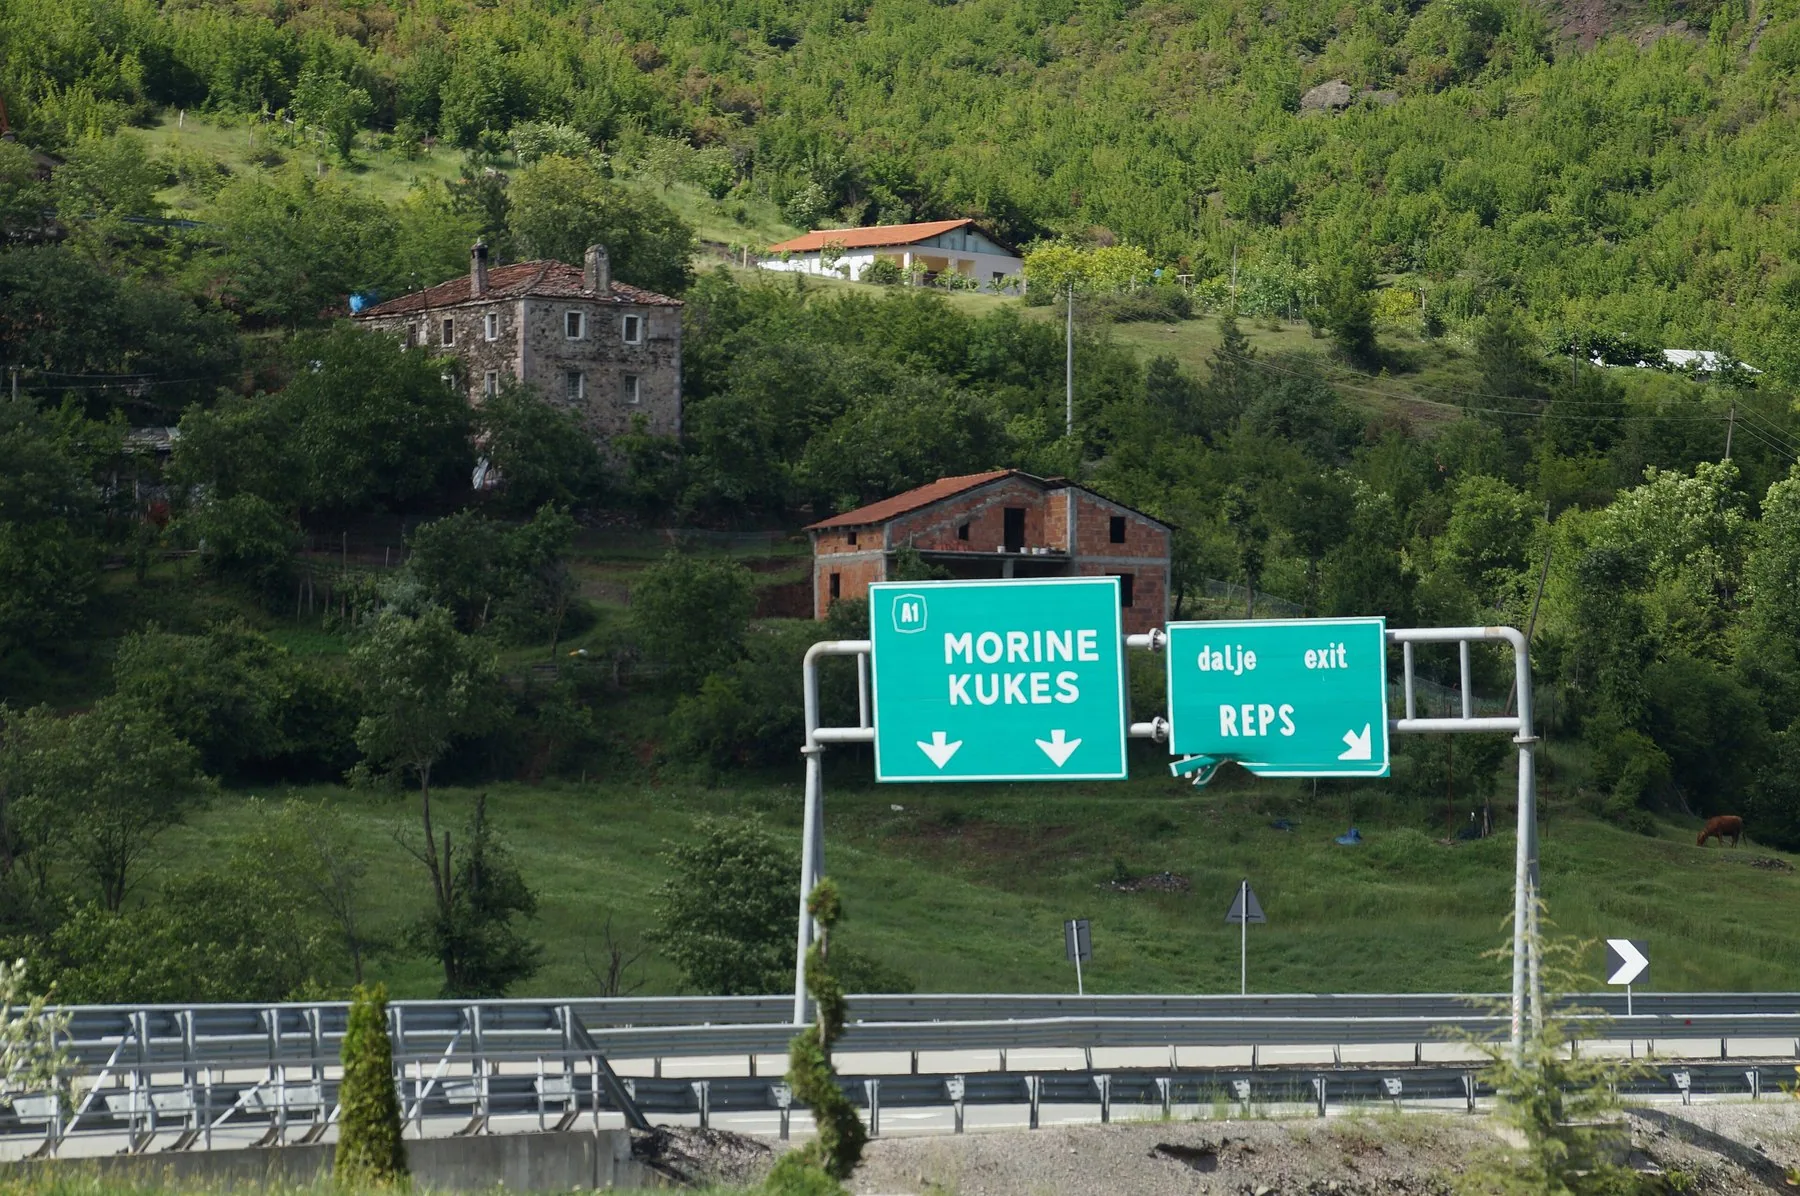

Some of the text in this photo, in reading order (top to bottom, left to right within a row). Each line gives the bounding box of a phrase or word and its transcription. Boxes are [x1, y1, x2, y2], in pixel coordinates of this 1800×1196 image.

[901, 602, 920, 623] A1
[943, 629, 1100, 665] MORINE
[1197, 644, 1257, 676] dalje
[1304, 642, 1348, 669] exit
[948, 671, 1080, 706] KUKES
[1219, 703, 1296, 737] REPS
